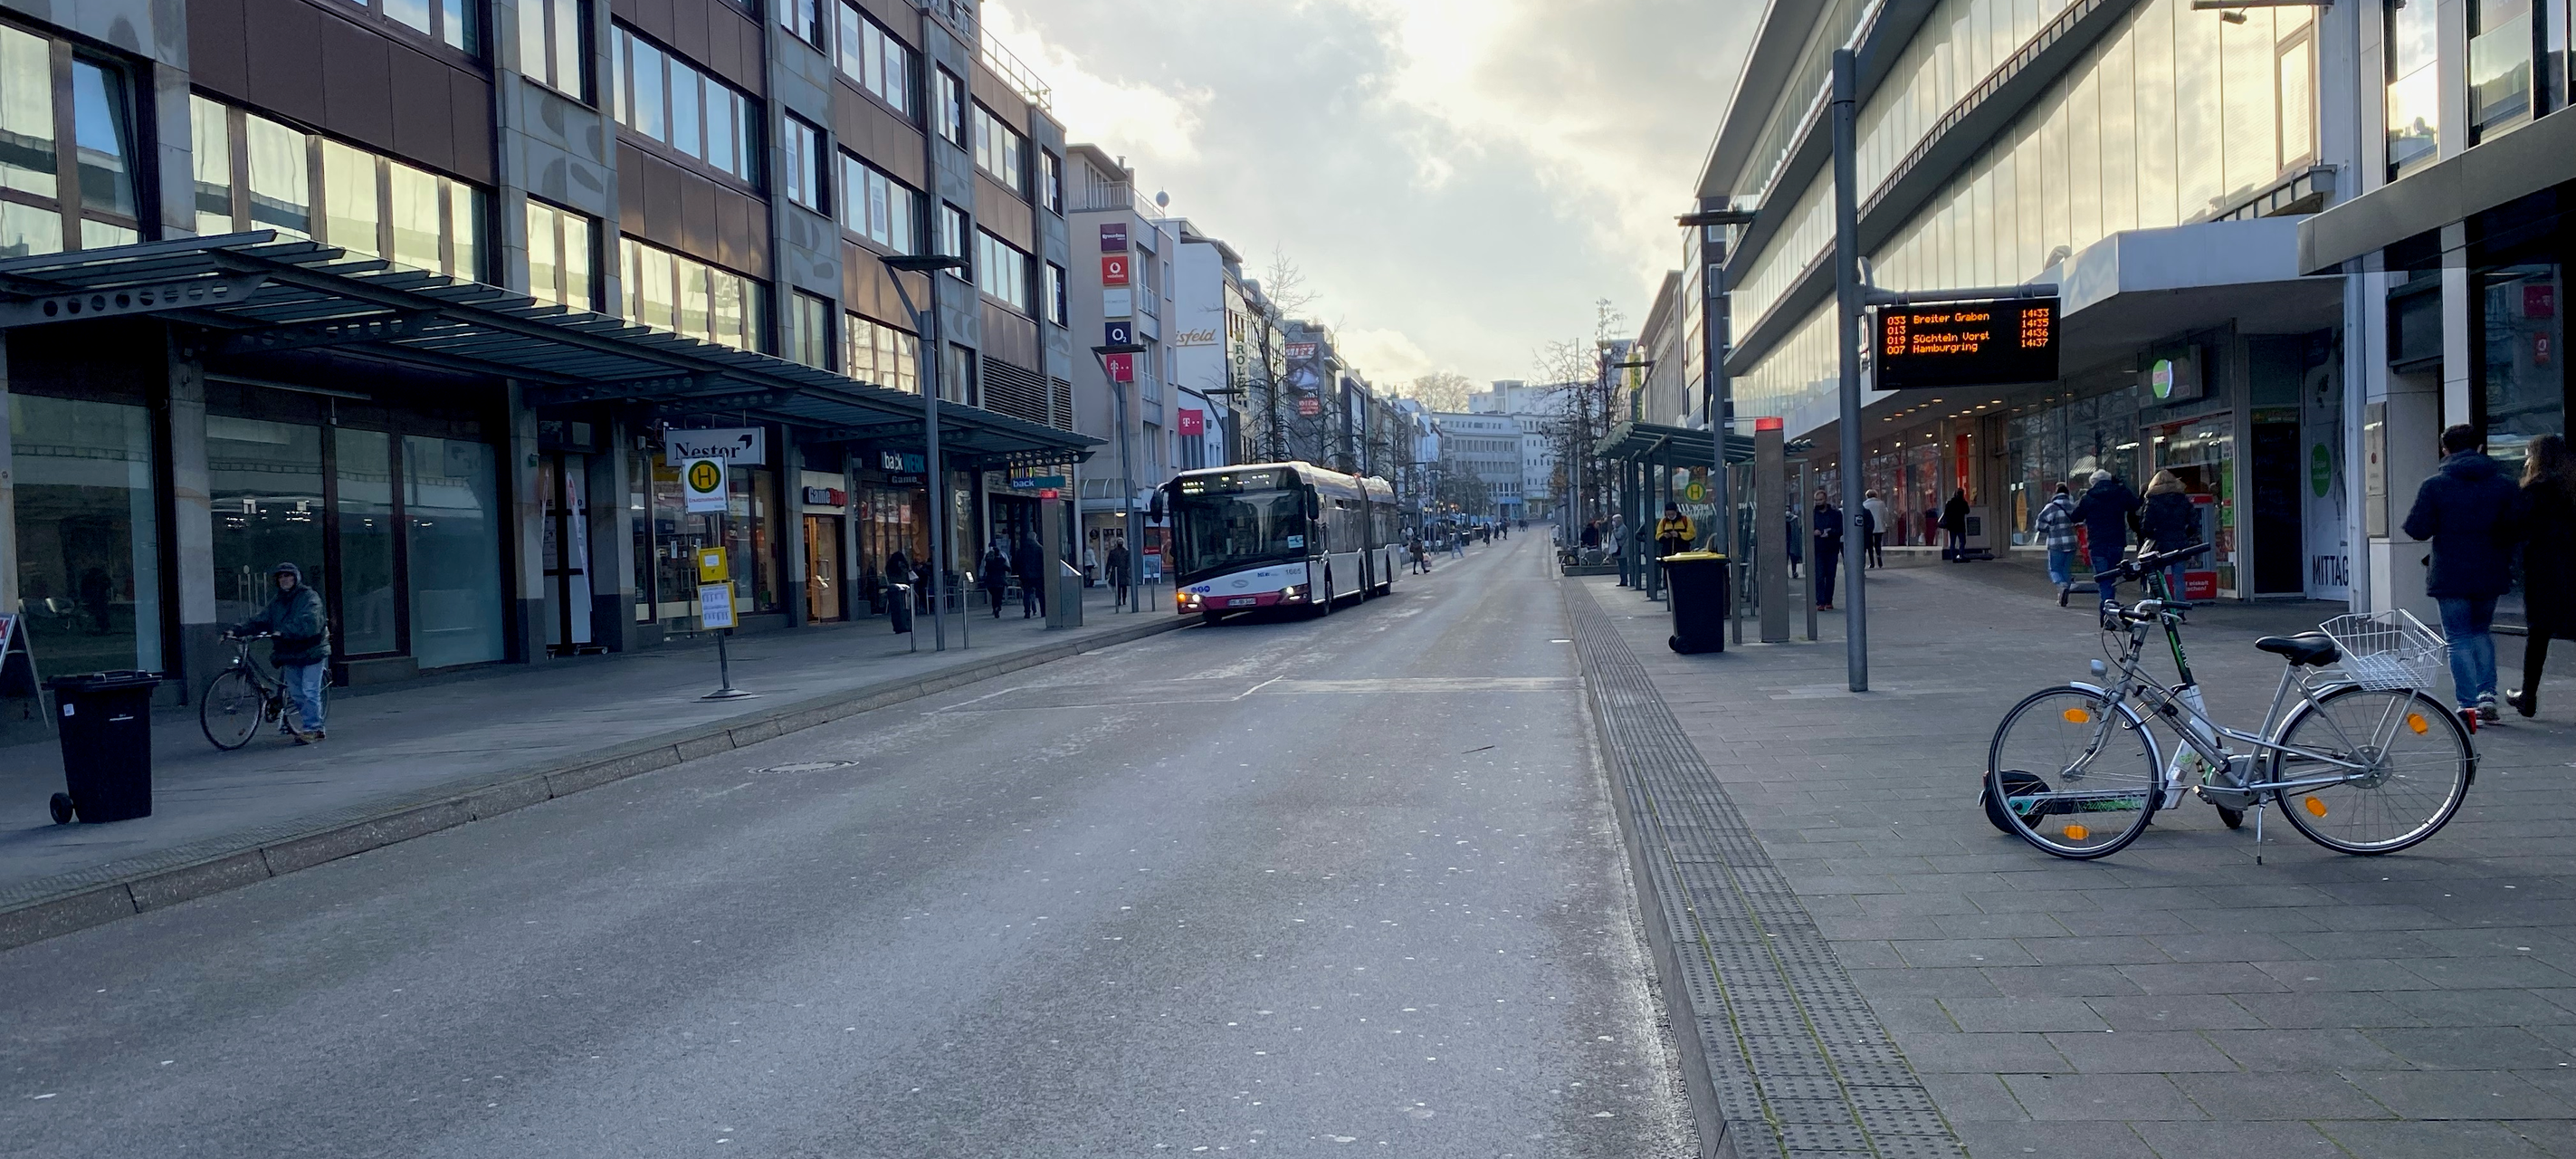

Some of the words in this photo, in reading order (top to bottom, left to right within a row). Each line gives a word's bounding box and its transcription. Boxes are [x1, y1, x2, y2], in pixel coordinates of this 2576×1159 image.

[1887, 315, 1906, 326] 033
[1913, 314, 1951, 324] Breiter
[1955, 311, 1989, 322] Graben
[2022, 308, 2049, 318] 14:33
[1887, 326, 1906, 335] 013
[2021, 318, 2049, 328] 14:35
[1887, 335, 1906, 345] 019
[1962, 330, 1989, 340] Vorst
[2021, 328, 2048, 338] 14:36
[1886, 345, 1906, 355] 007
[1913, 341, 1979, 354] Hamburgring
[2021, 338, 2048, 348] 14:37
[674, 442, 740, 460] Nestor
[698, 467, 711, 486] H
[1690, 485, 1700, 498] H
[2313, 554, 2349, 587] MITTAG
